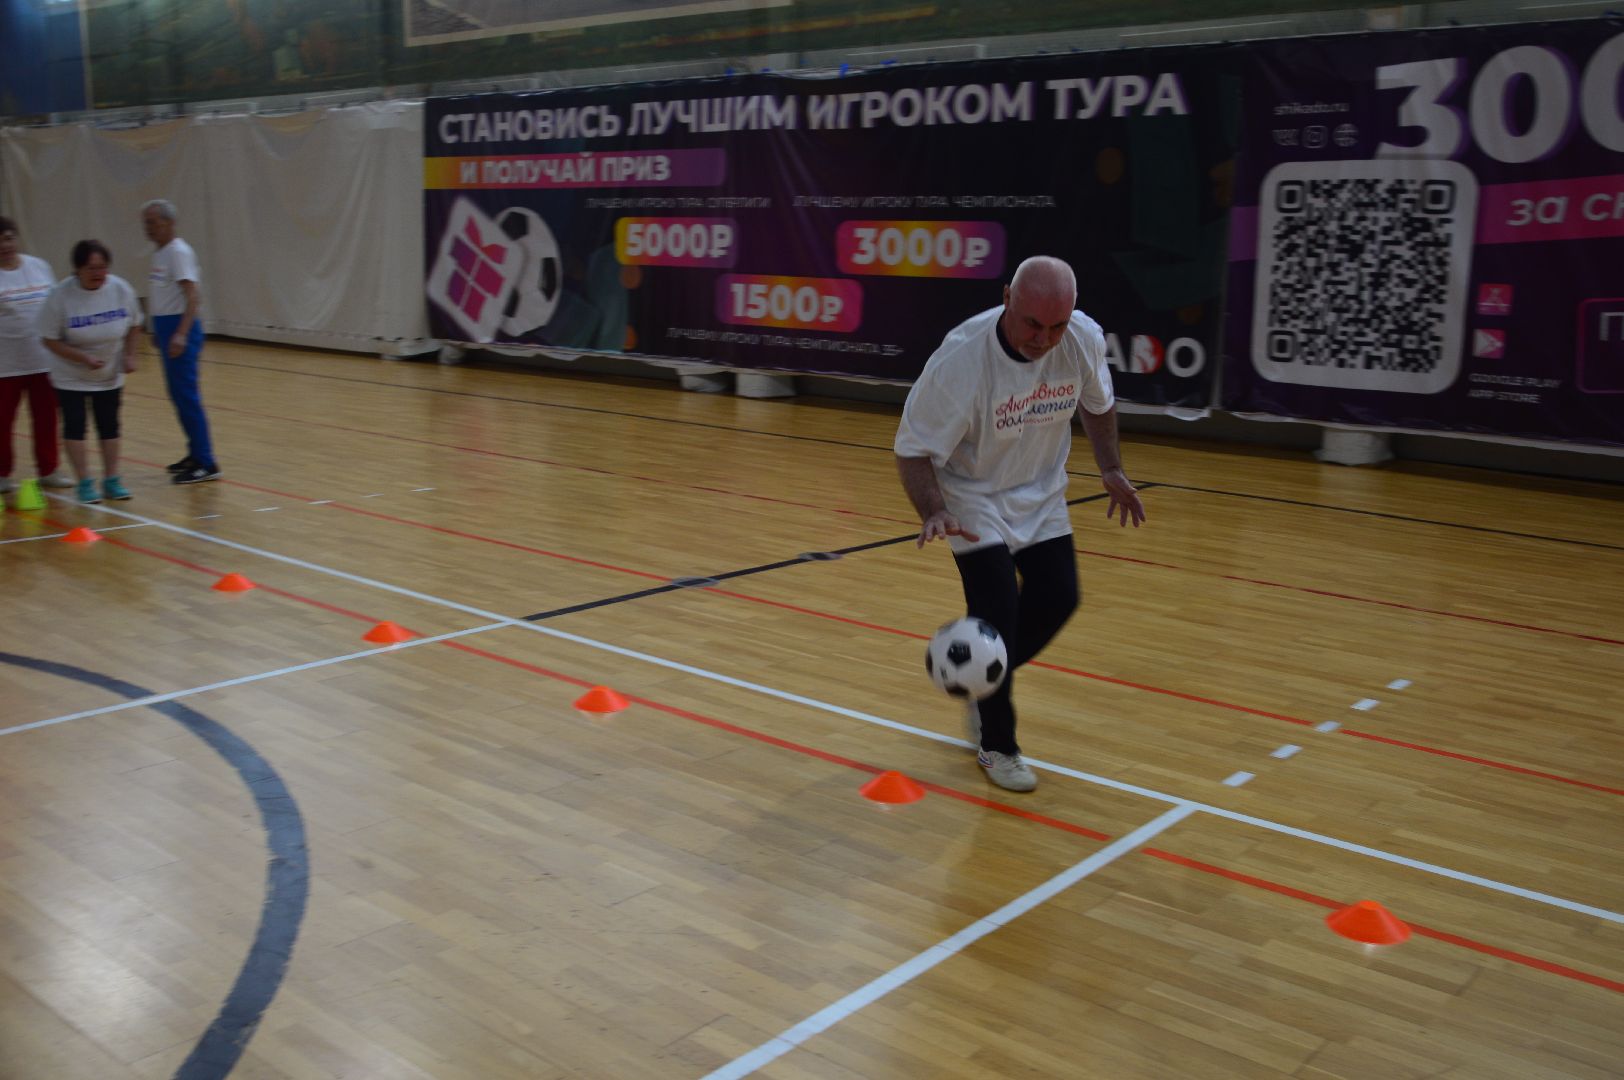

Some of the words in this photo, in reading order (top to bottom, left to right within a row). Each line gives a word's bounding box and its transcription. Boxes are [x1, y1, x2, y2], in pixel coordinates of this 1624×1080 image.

[439, 105, 622, 144] СТАНОВИСЬ
[627, 95, 798, 137] ЛУЧШИМ
[807, 80, 1034, 130] ИГРОКОМ
[1043, 72, 1189, 121] ТУРА
[459, 161, 479, 184] И
[482, 152, 596, 184] ПОЛУЧАЙ
[600, 155, 671, 183] ПРИЗ
[1504, 195, 1569, 227] за
